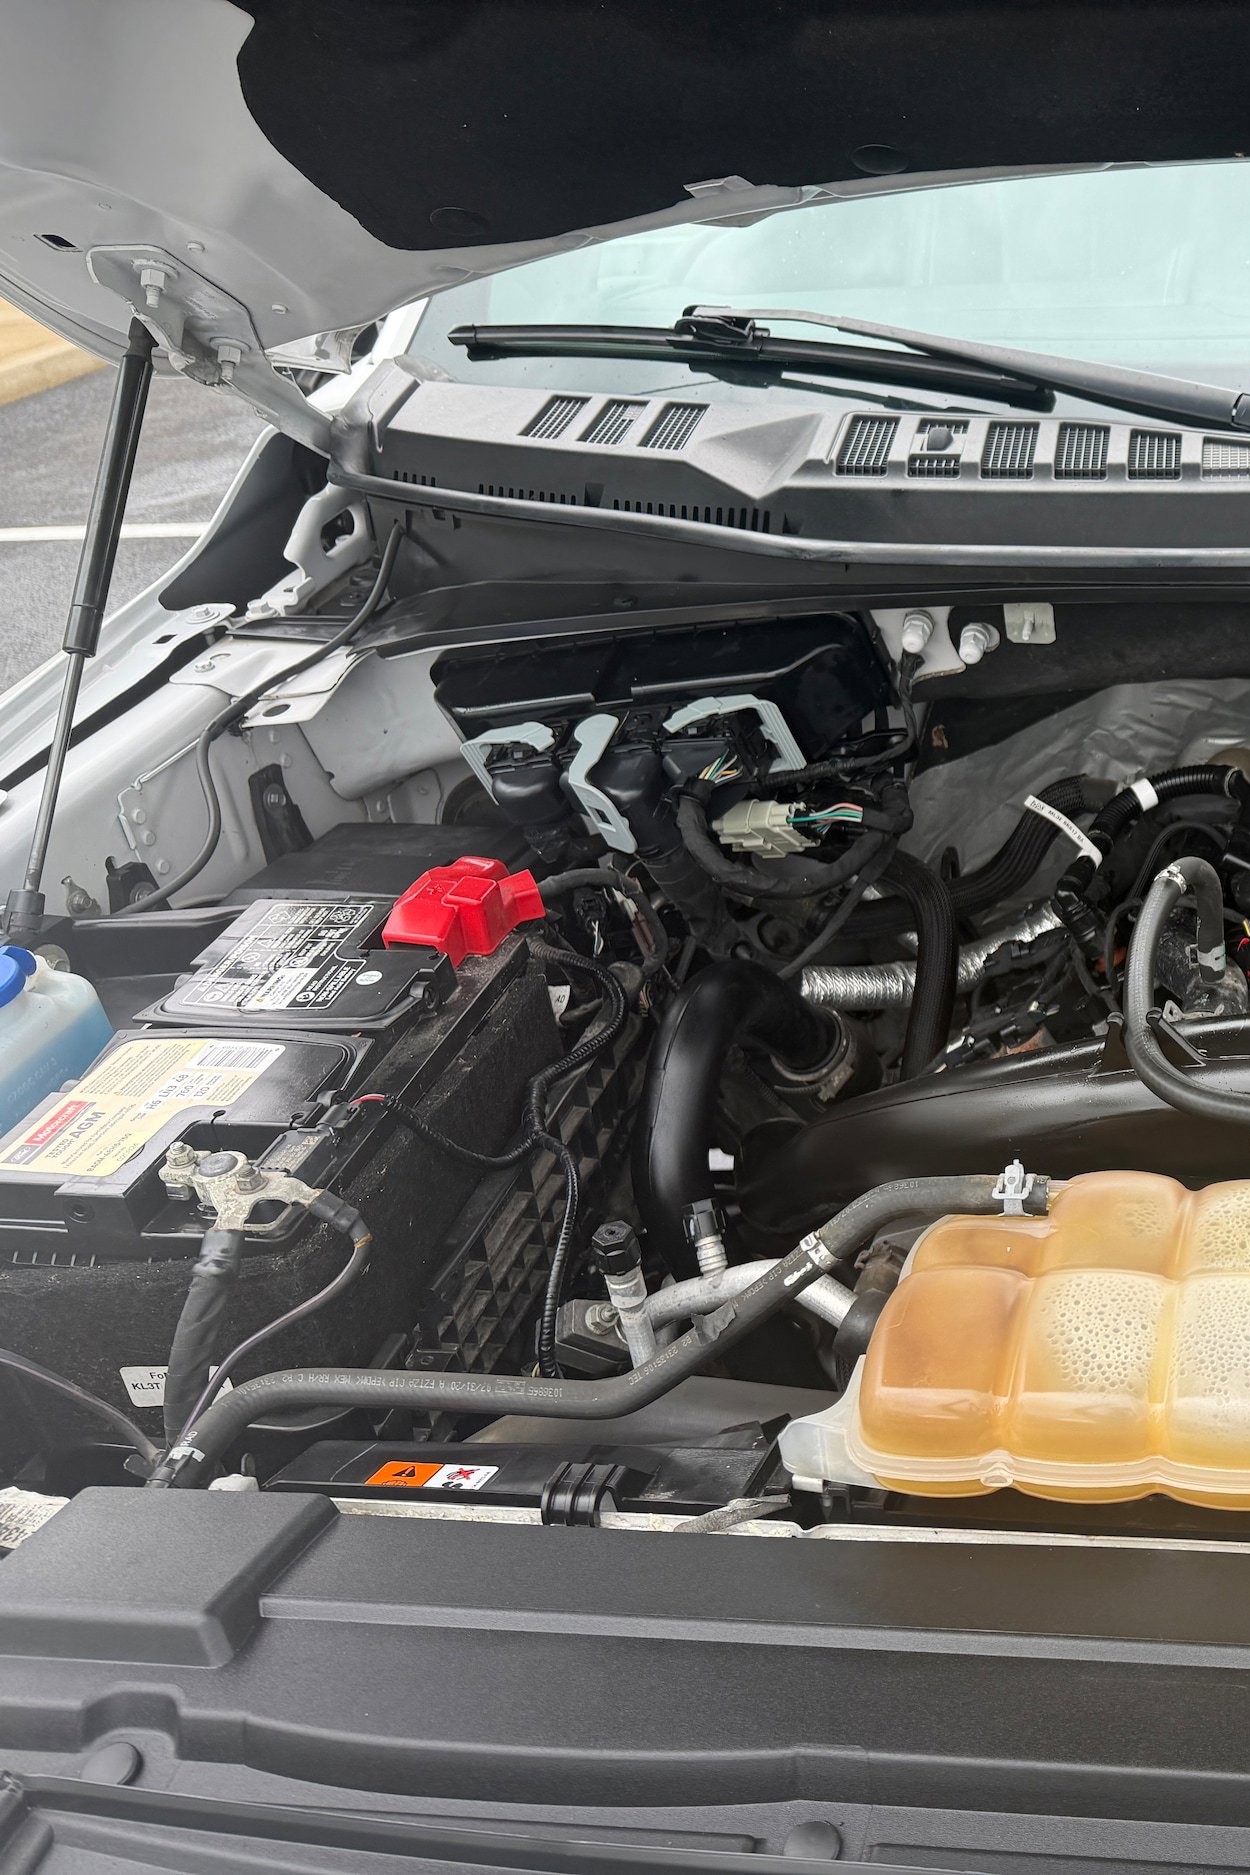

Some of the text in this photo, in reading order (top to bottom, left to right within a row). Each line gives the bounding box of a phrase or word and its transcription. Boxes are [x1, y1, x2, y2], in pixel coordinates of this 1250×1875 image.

[175, 1085, 193, 1098] 760
[194, 1087, 210, 1097] 120
[146, 1099, 162, 1110] H6
[33, 1104, 80, 1142] Motorcraft
[69, 1111, 106, 1138] AGM
[45, 1138, 69, 1159] TESTED
[644, 1346, 679, 1376] 23:35:06
[334, 1374, 351, 1384] MEX
[628, 1371, 643, 1385] TEC
